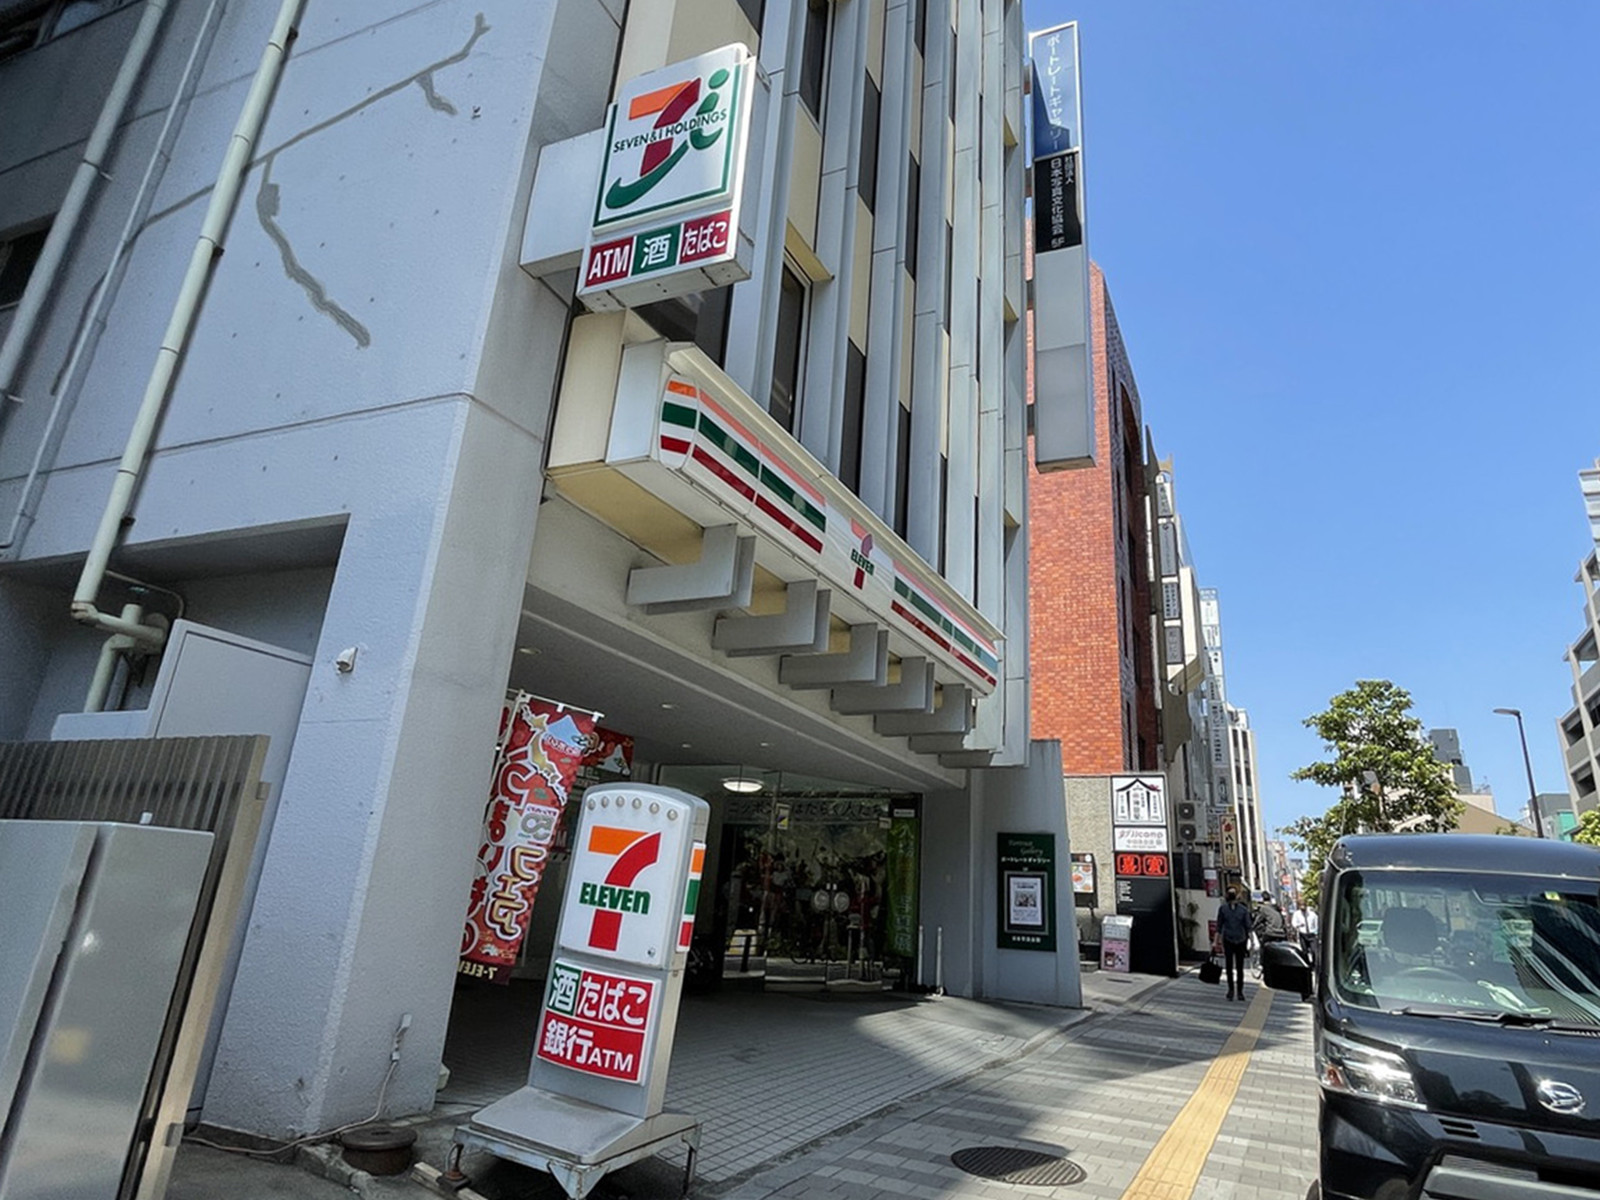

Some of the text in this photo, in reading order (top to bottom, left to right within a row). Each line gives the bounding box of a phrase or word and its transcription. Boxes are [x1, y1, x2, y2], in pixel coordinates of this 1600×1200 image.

[613, 133, 649, 153] SEVEN
[665, 109, 727, 137] HOLDINGS
[641, 233, 672, 268] 酒
[682, 221, 727, 257] たばこ
[588, 244, 630, 280] ATM
[549, 967, 579, 1011] 酒
[577, 976, 647, 1025] たばこ
[543, 1018, 633, 1072] 銀行ATM
